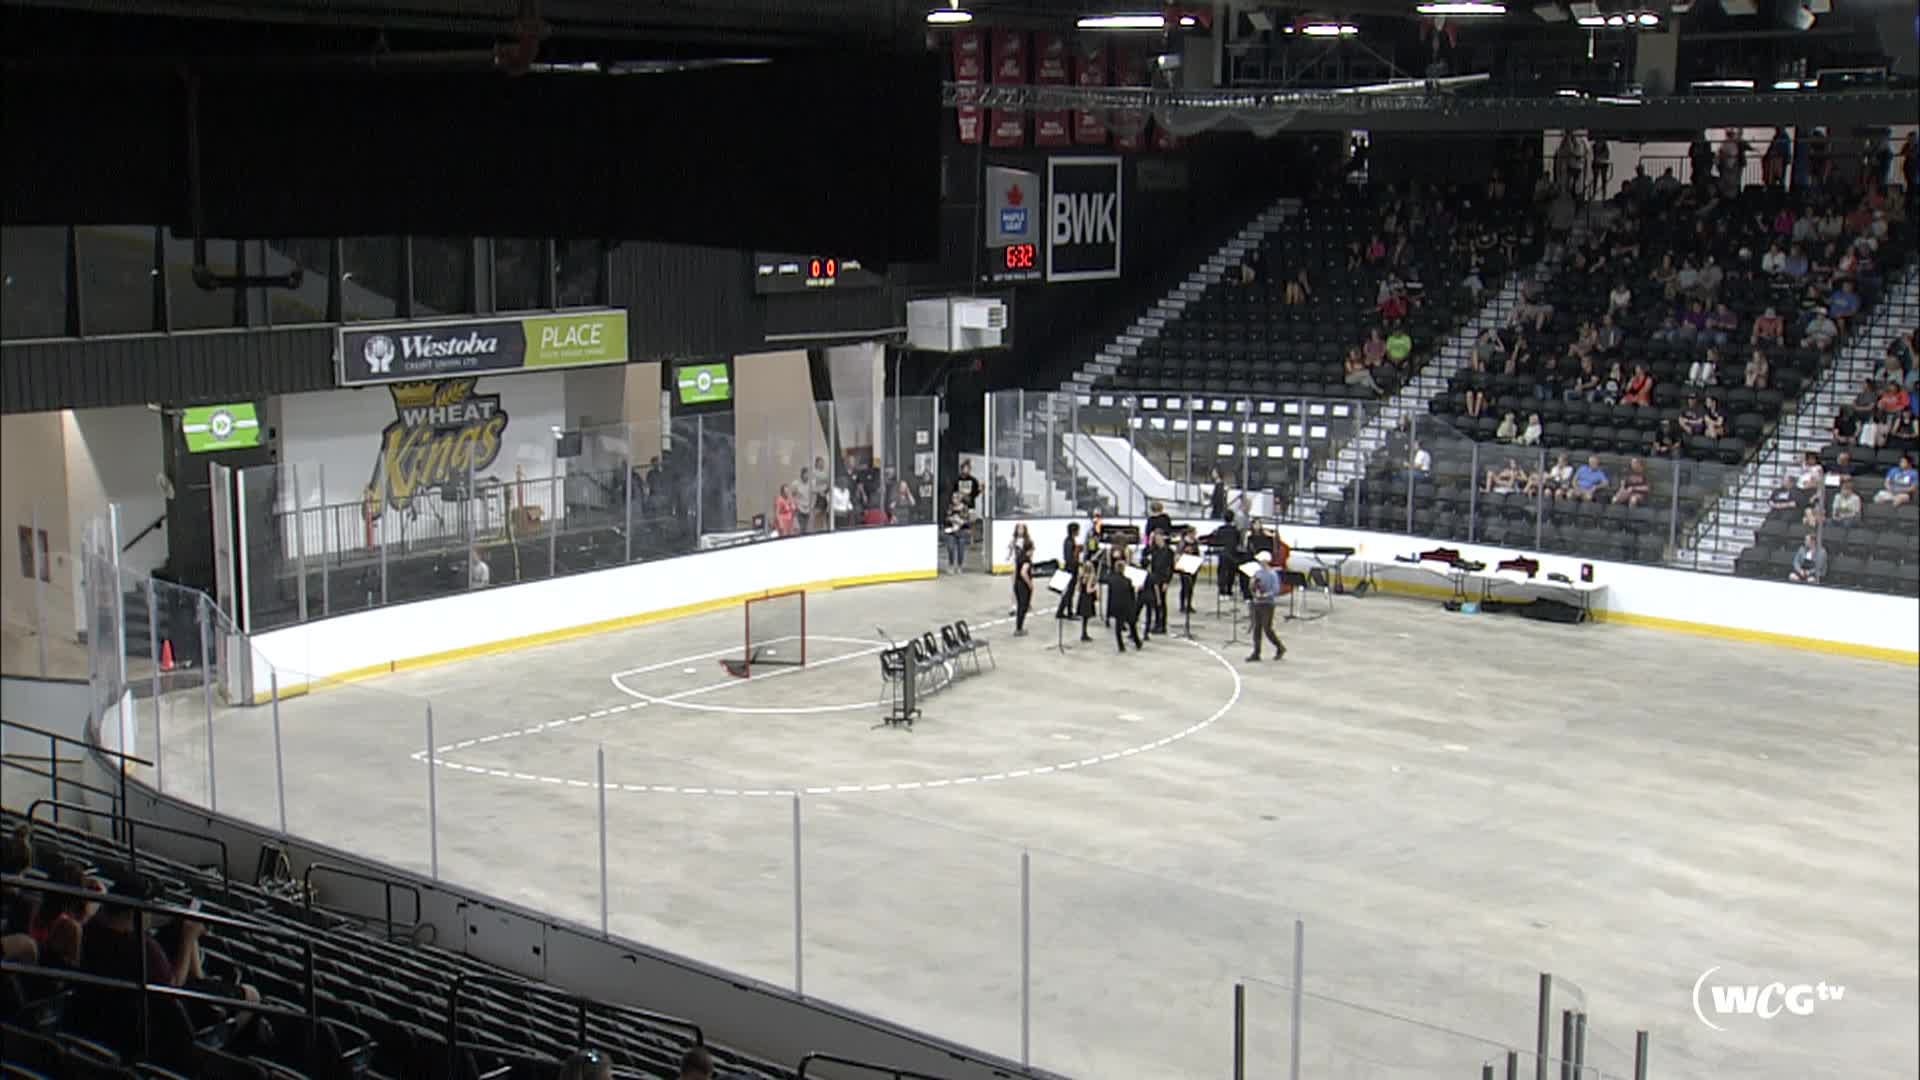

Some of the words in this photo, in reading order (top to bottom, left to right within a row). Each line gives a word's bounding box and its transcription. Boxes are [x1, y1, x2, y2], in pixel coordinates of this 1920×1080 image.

[1053, 193, 1116, 245] BWK
[400, 331, 497, 359] Westoba
[541, 323, 602, 349] PLACE
[403, 401, 495, 428] WHEAT
[384, 416, 506, 503] Kings
